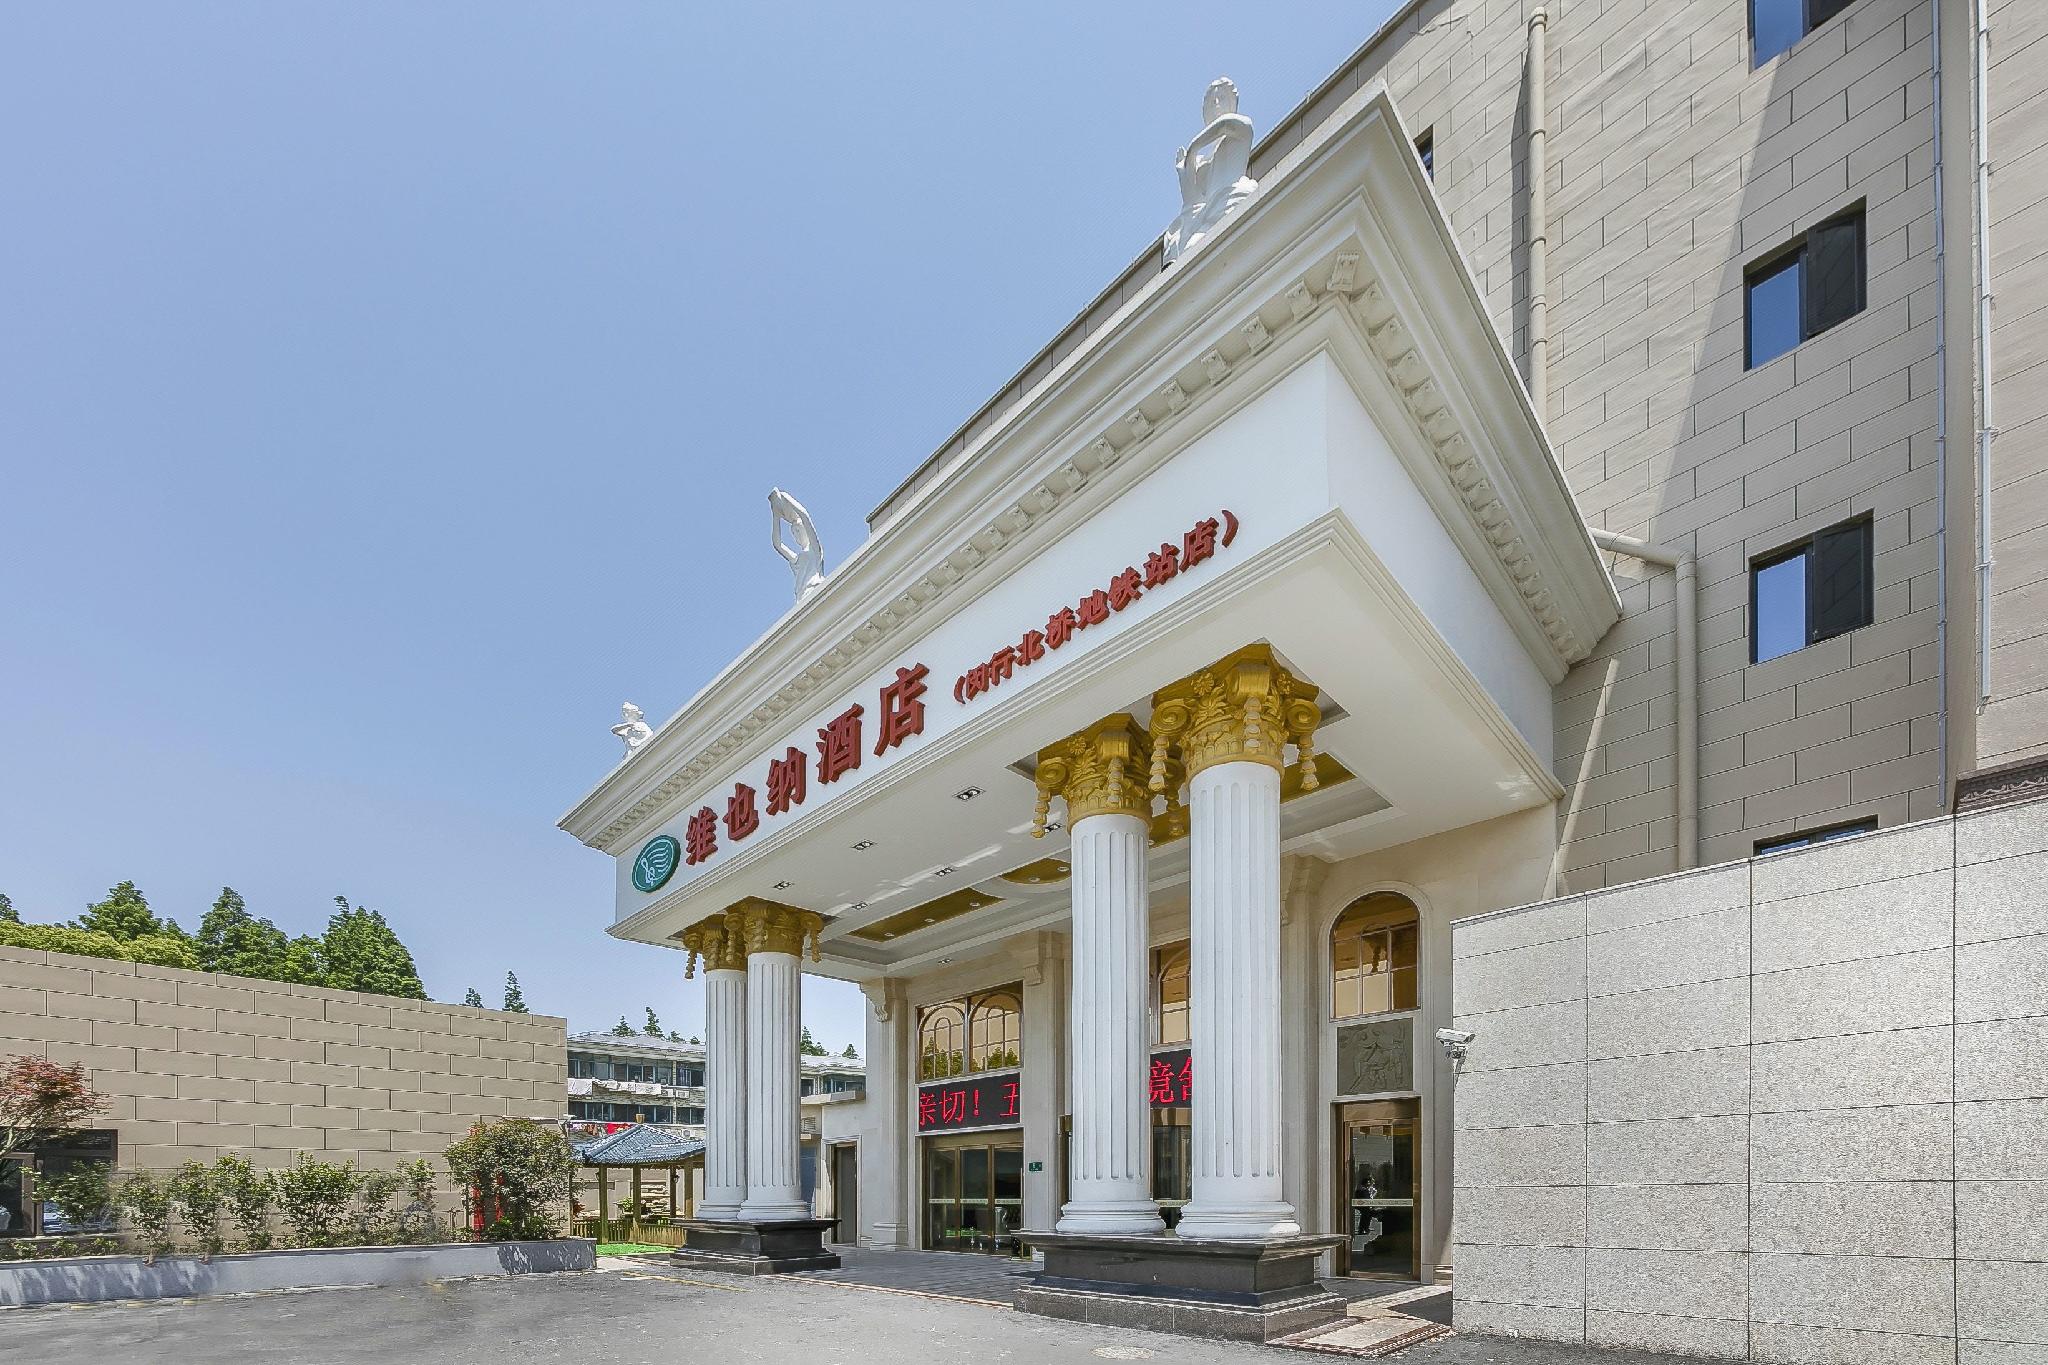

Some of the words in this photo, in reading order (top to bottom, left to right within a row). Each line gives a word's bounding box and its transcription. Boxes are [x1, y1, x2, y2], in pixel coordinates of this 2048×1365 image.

[686, 663, 929, 865] 维也纳酒店
